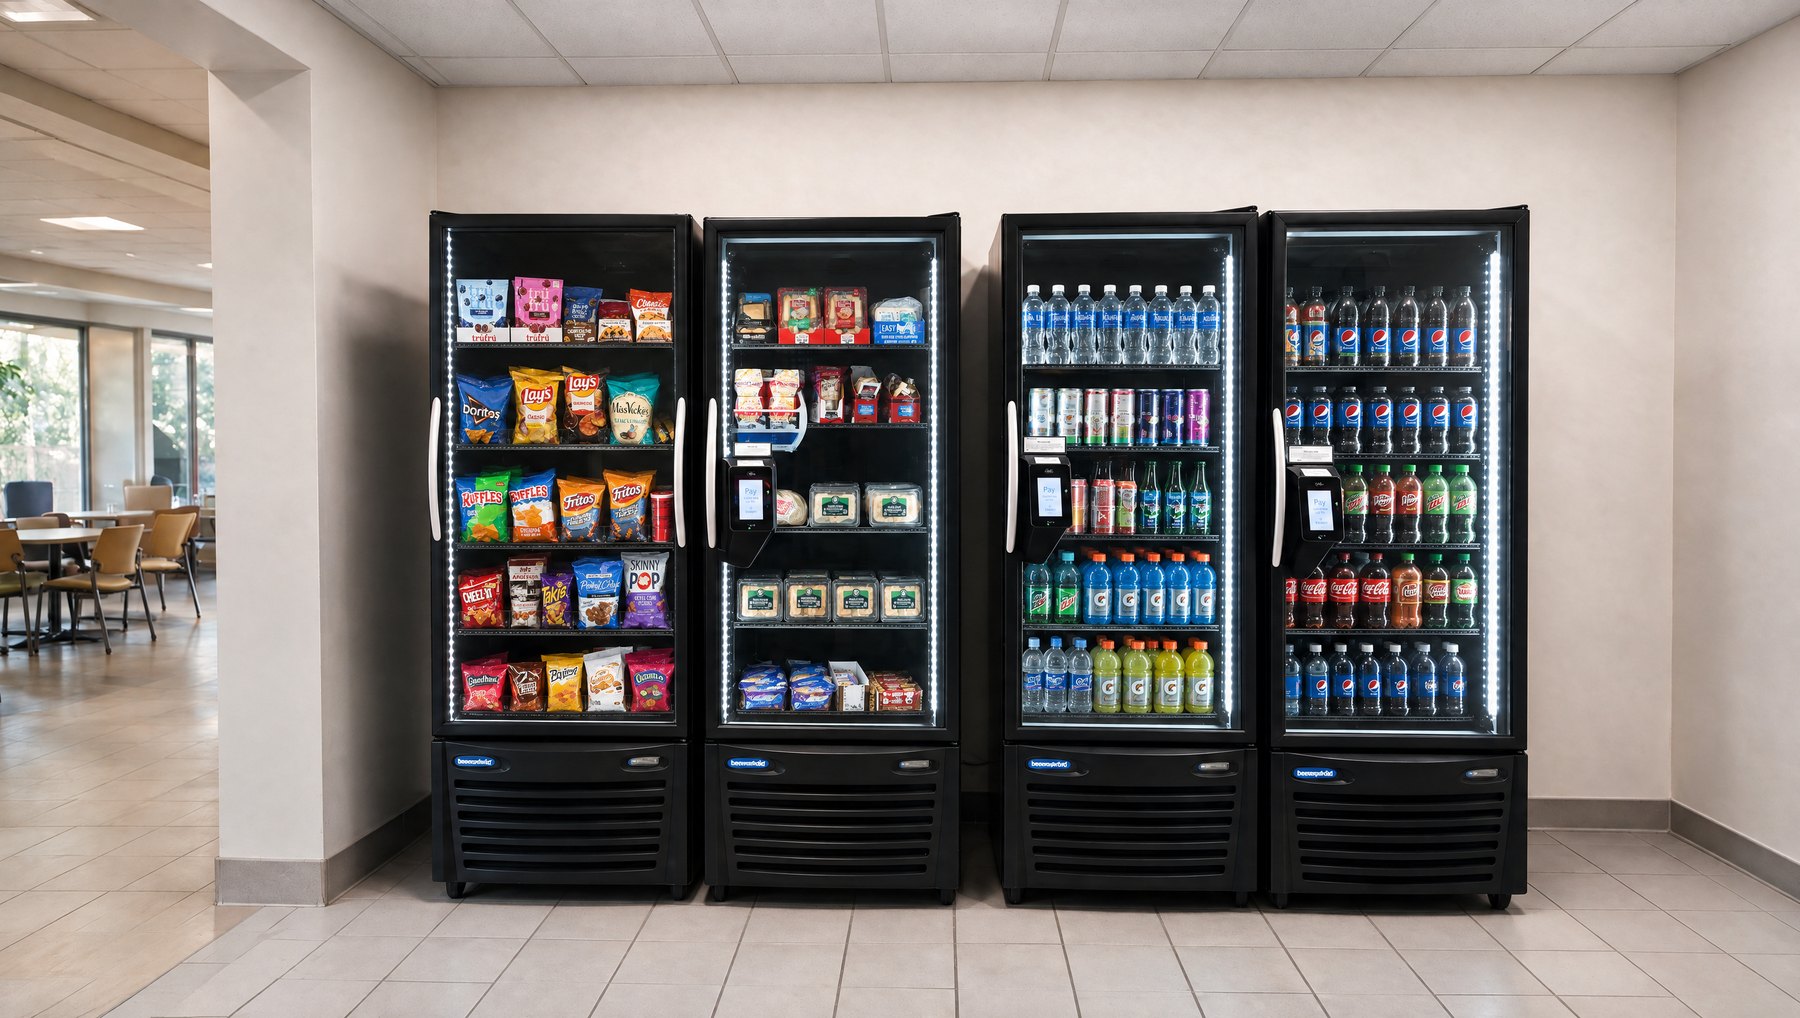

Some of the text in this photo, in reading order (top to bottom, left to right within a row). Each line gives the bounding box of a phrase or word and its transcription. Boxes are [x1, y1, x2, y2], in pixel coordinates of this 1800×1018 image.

[568, 375, 597, 392] Lay's
[523, 387, 552, 404] Lay's
[462, 403, 500, 421] Doritos
[462, 490, 503, 507] RUFFLES
[612, 485, 641, 501] Fritos
[744, 487, 757, 496] Pay
[1043, 486, 1056, 494] Pay
[563, 493, 594, 510] Fritos
[1313, 498, 1326, 507] Pay
[630, 559, 660, 571] SKINNY
[629, 571, 660, 591] POP
[541, 585, 568, 604] Takis
